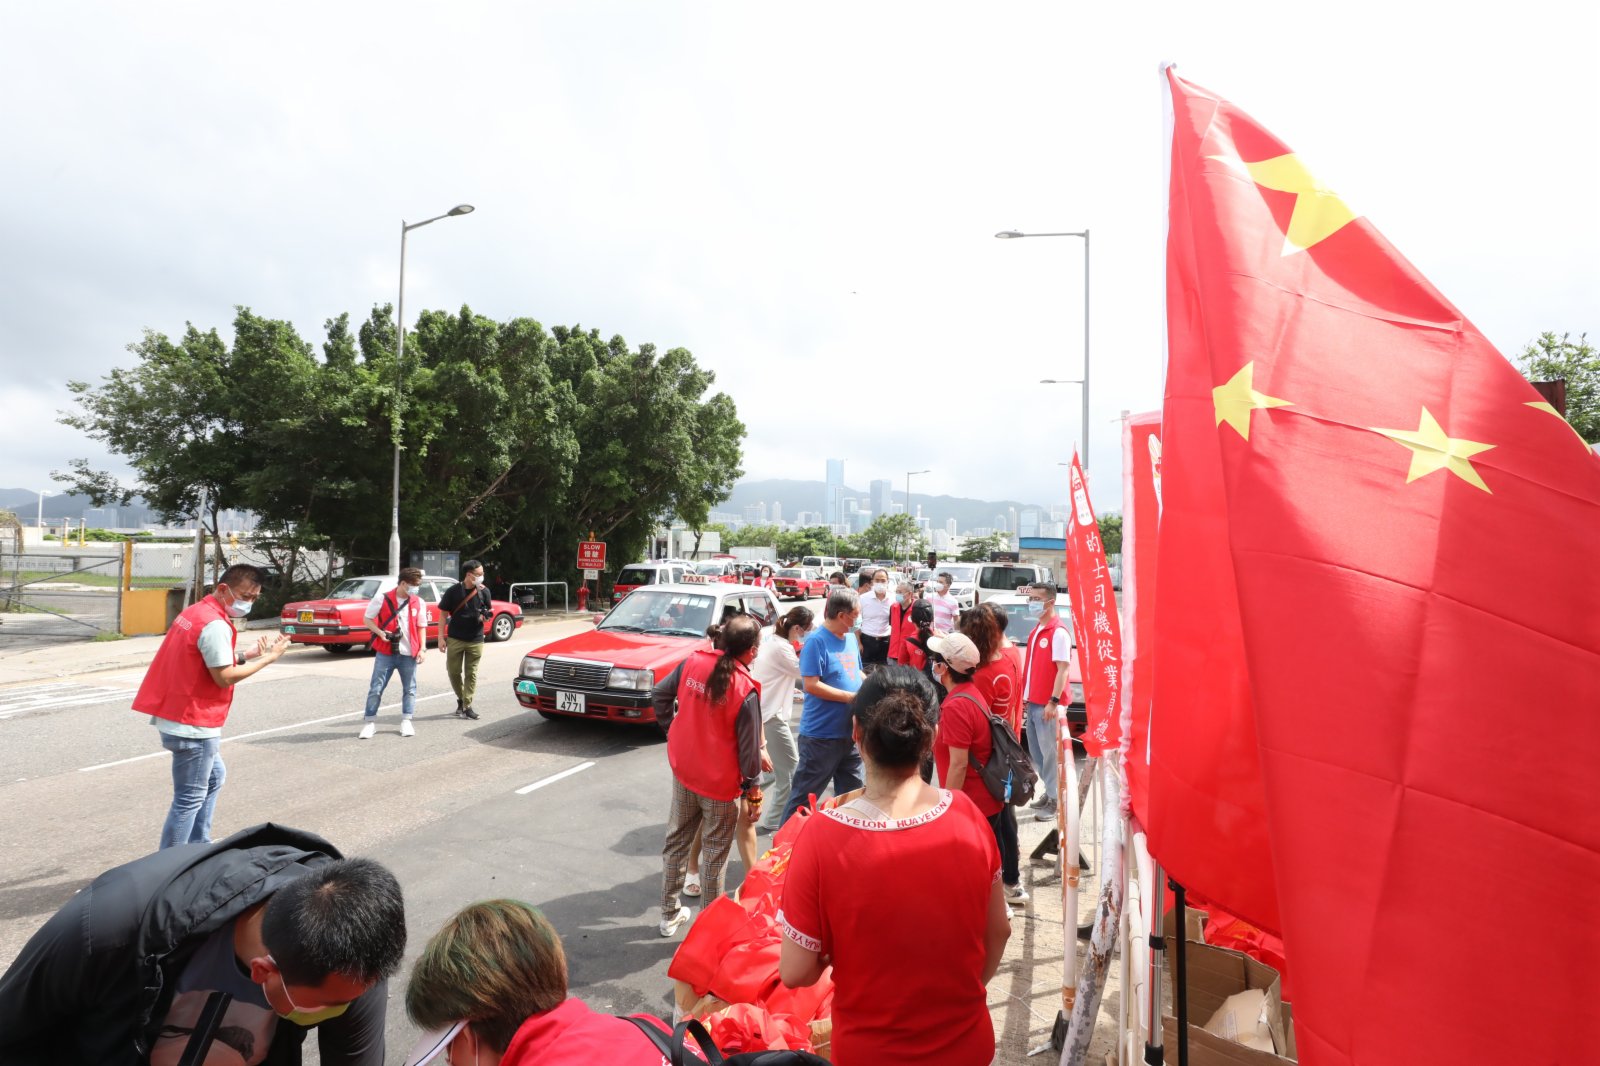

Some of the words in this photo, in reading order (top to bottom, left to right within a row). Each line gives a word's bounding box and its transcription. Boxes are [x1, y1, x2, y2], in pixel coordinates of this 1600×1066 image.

[682, 575, 705, 583] TAXI
[564, 692, 577, 702] NN
[560, 701, 582, 712] 4771
